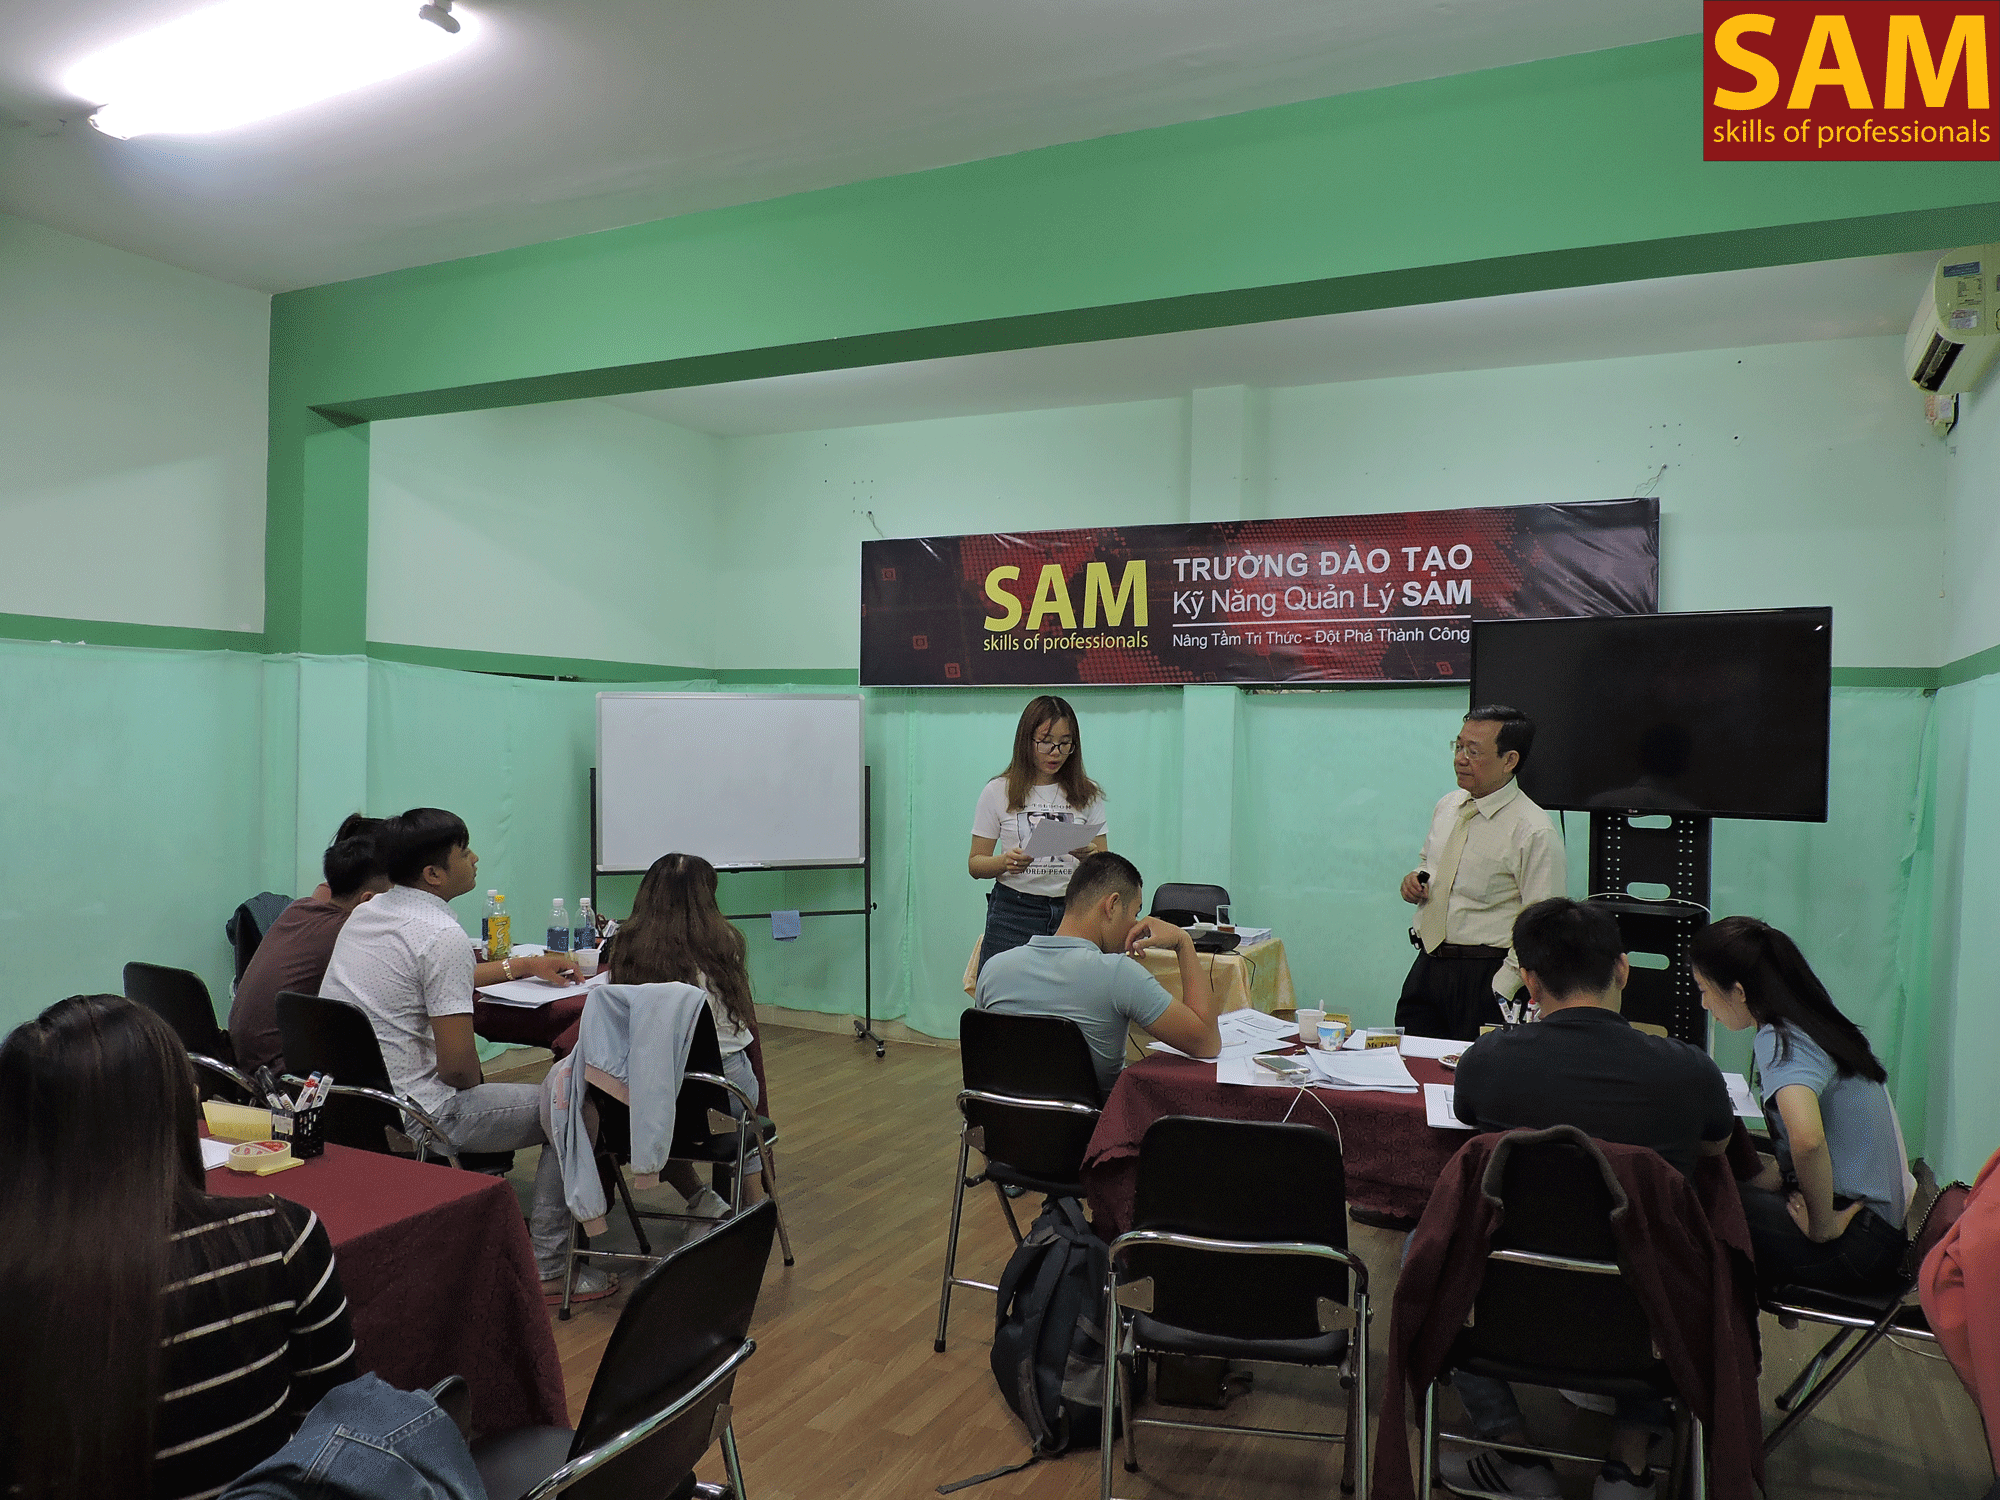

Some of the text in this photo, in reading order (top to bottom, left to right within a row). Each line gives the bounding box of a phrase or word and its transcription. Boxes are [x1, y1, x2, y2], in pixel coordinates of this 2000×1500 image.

[1172, 543, 1473, 582] TRƯỜNG ĐÀO TẠO
[983, 559, 1149, 632] SAM
[1173, 579, 1472, 620] Kỹ Năng Quản Lý SAM
[983, 630, 1149, 654] skills of professionals
[1172, 633, 1208, 650] Nâng
[1211, 629, 1241, 646] Tầm
[1265, 630, 1302, 645] Thức
[1314, 630, 1340, 645] Đột
[1344, 628, 1373, 643] Phá
[1376, 627, 1425, 642] Thành
[1429, 626, 1470, 644] Công
